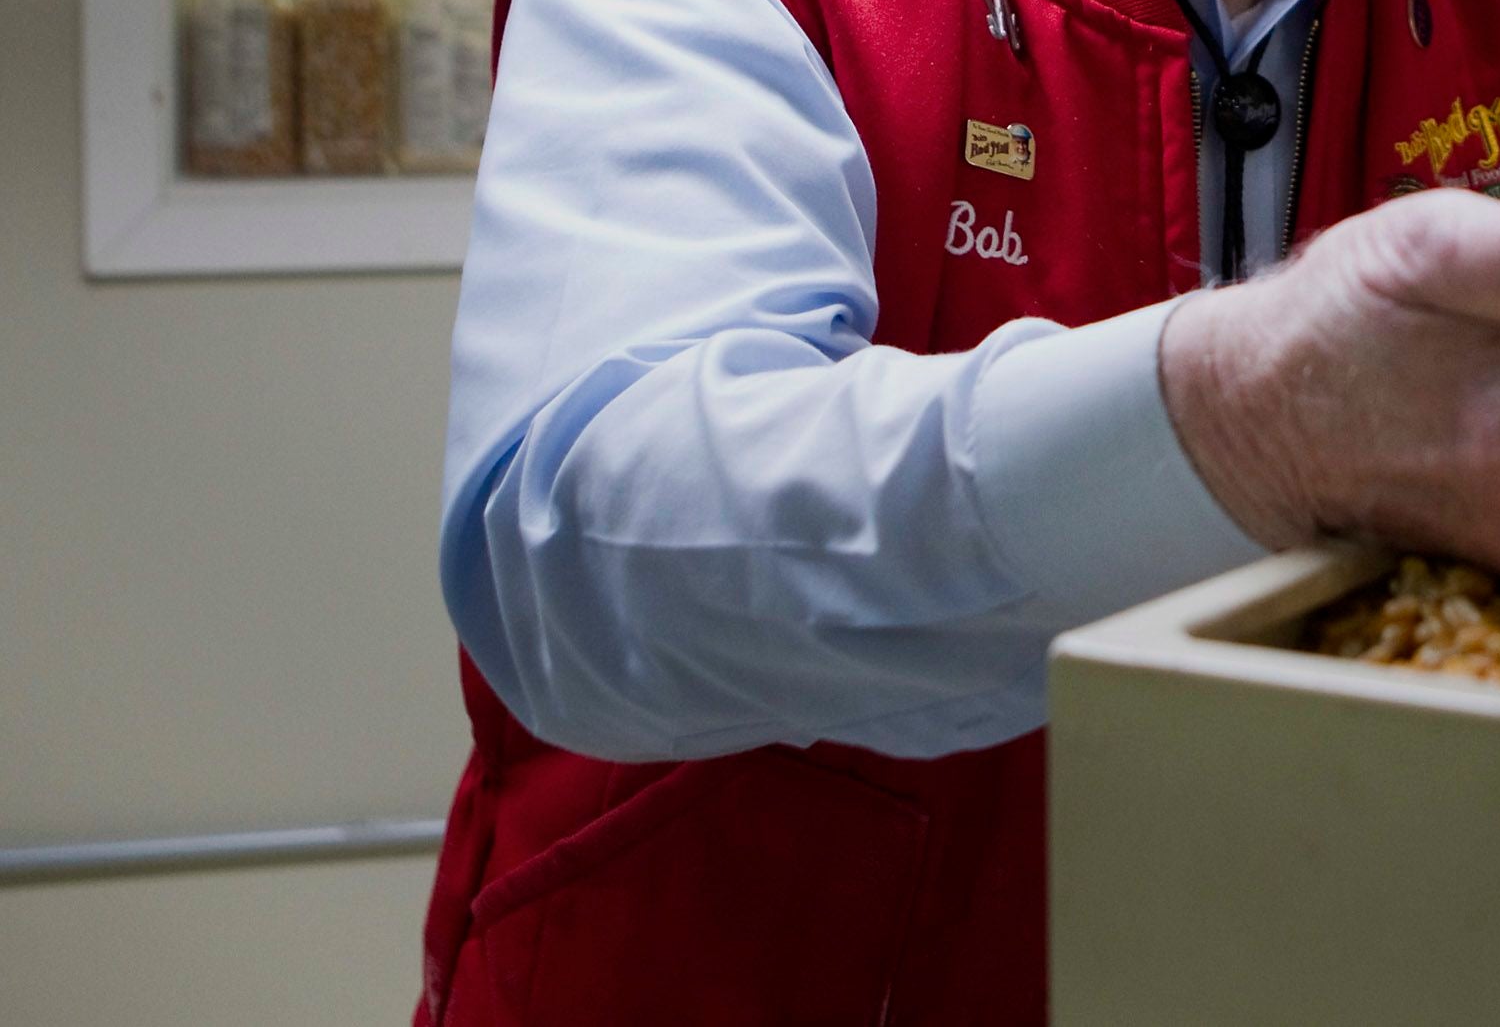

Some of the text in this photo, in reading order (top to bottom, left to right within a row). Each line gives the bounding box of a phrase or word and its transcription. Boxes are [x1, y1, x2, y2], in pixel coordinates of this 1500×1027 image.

[969, 140, 1010, 159] Red Mill
[1395, 130, 1426, 166] Bob's
[1420, 96, 1470, 175] Red
[944, 200, 1029, 266] Bob
